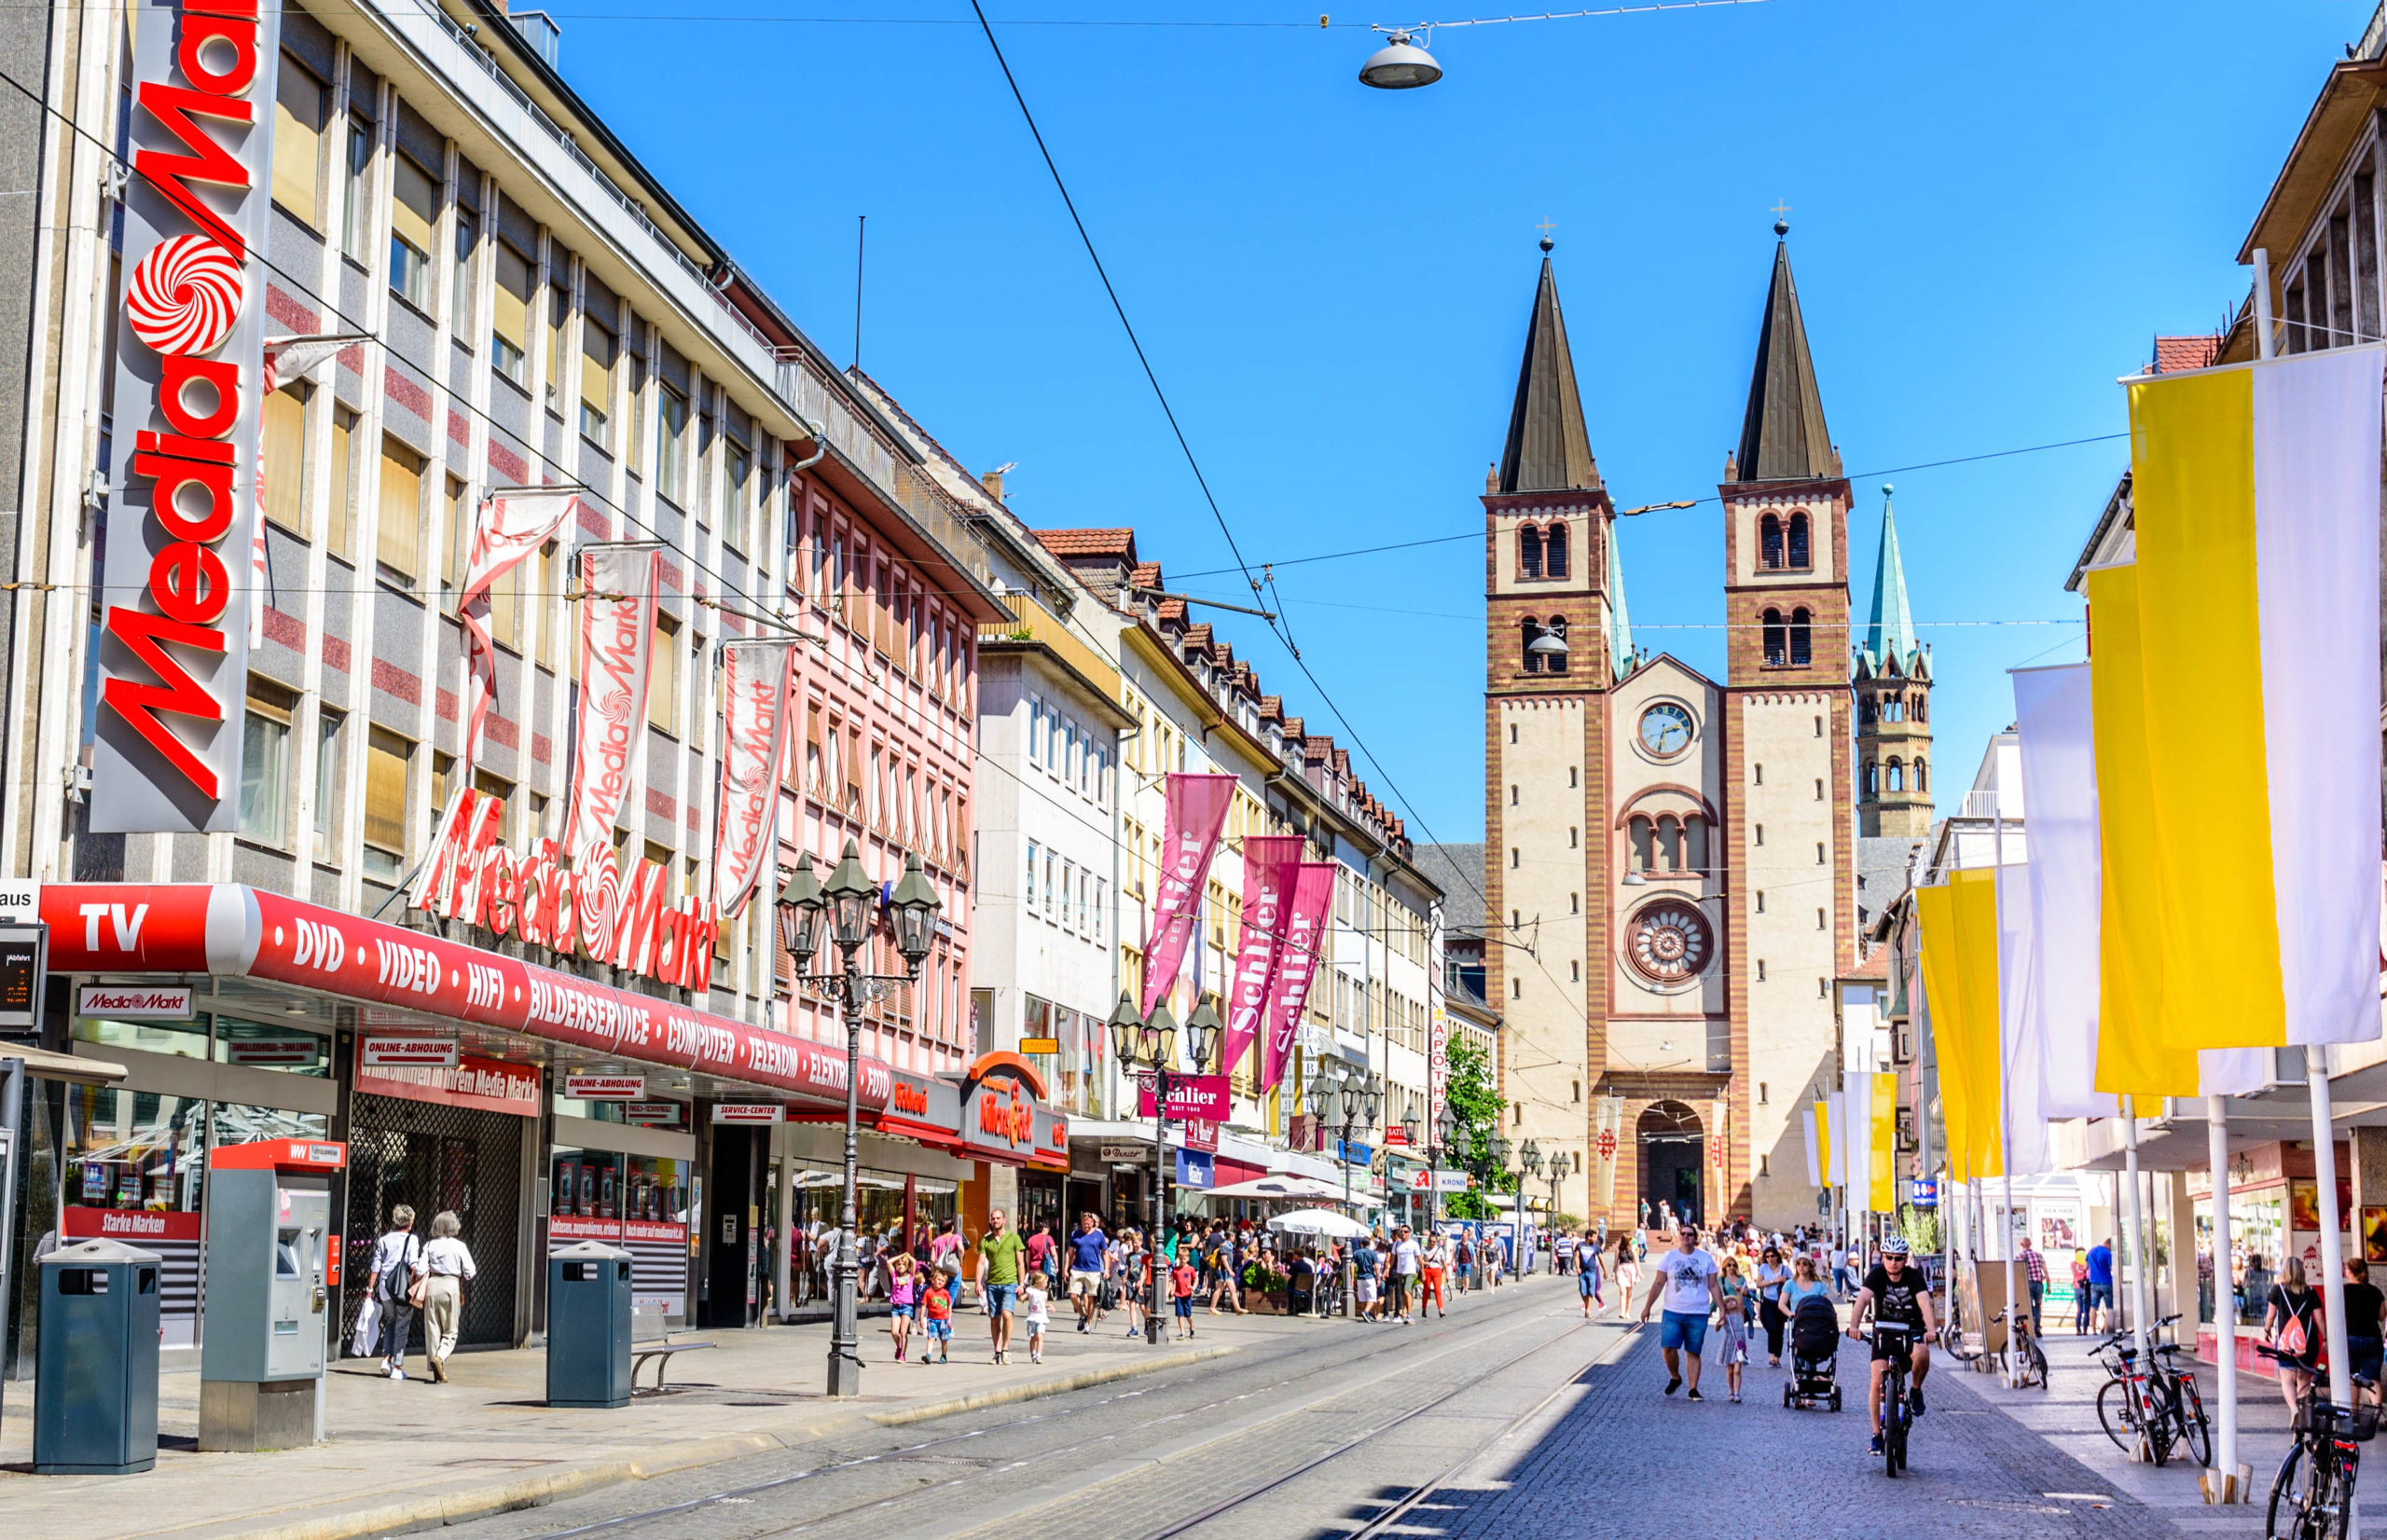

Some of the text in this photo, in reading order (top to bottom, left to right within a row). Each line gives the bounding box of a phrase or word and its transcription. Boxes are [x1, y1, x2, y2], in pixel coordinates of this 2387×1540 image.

[104, 355, 240, 799] Media
[589, 591, 640, 837] Media Markt
[730, 679, 776, 884] Media Markt
[409, 787, 719, 994] Media Markt
[79, 903, 149, 952] TV
[293, 917, 345, 972] DVD
[376, 938, 441, 995] VIDEO
[1231, 886, 1278, 1034] Schlier
[86, 994, 184, 1010] Media Markt
[466, 962, 505, 1010] HIFI
[530, 979, 650, 1046] BILDERSERVICE
[368, 1042, 453, 1053] ONLINE-ABHOLUNG
[667, 1015, 736, 1065] COMPUTER
[748, 1037, 799, 1079] TELEKOM
[443, 1067, 475, 1093] Ihrem
[475, 1069, 504, 1099] Media
[506, 1075, 535, 1103] Markt
[568, 1079, 642, 1089] ONLINE-ABHOLUNG
[809, 1052, 849, 1091] ELEKTR
[866, 1066, 890, 1100] FOTO
[1156, 1086, 1217, 1105] chlier
[720, 1106, 776, 1114] SERVICE-CENTER
[103, 1213, 166, 1233] Starke Marken
